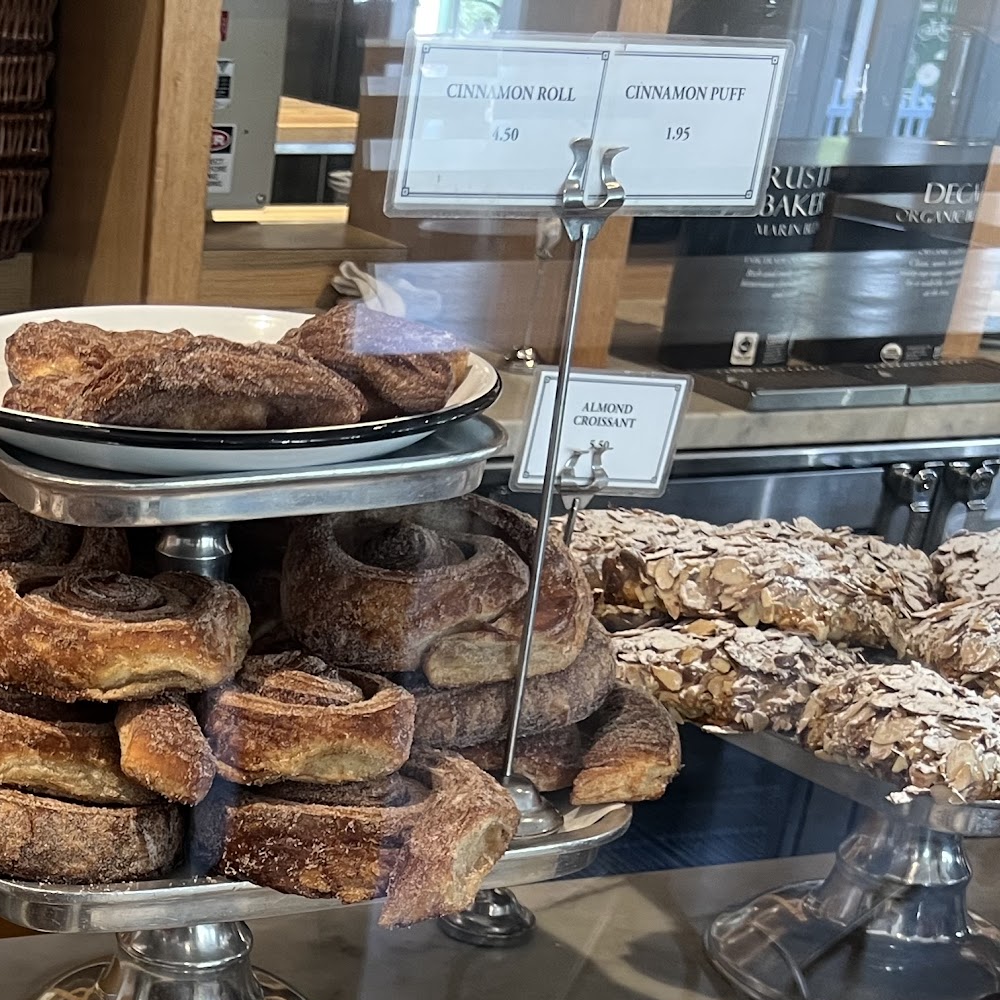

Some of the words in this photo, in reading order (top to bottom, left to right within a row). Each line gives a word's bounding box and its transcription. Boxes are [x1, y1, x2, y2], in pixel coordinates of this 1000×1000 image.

[446, 83, 535, 101] CINNAMON
[537, 86, 576, 102] ROLL
[625, 84, 707, 101] CINNAMON
[709, 86, 746, 102] PUFF
[491, 126, 519, 142] 4.50
[665, 126, 690, 141] 1.95
[582, 402, 633, 414] ALMOND
[573, 416, 637, 428] CROISSANT
[589, 439, 609, 450] 550
